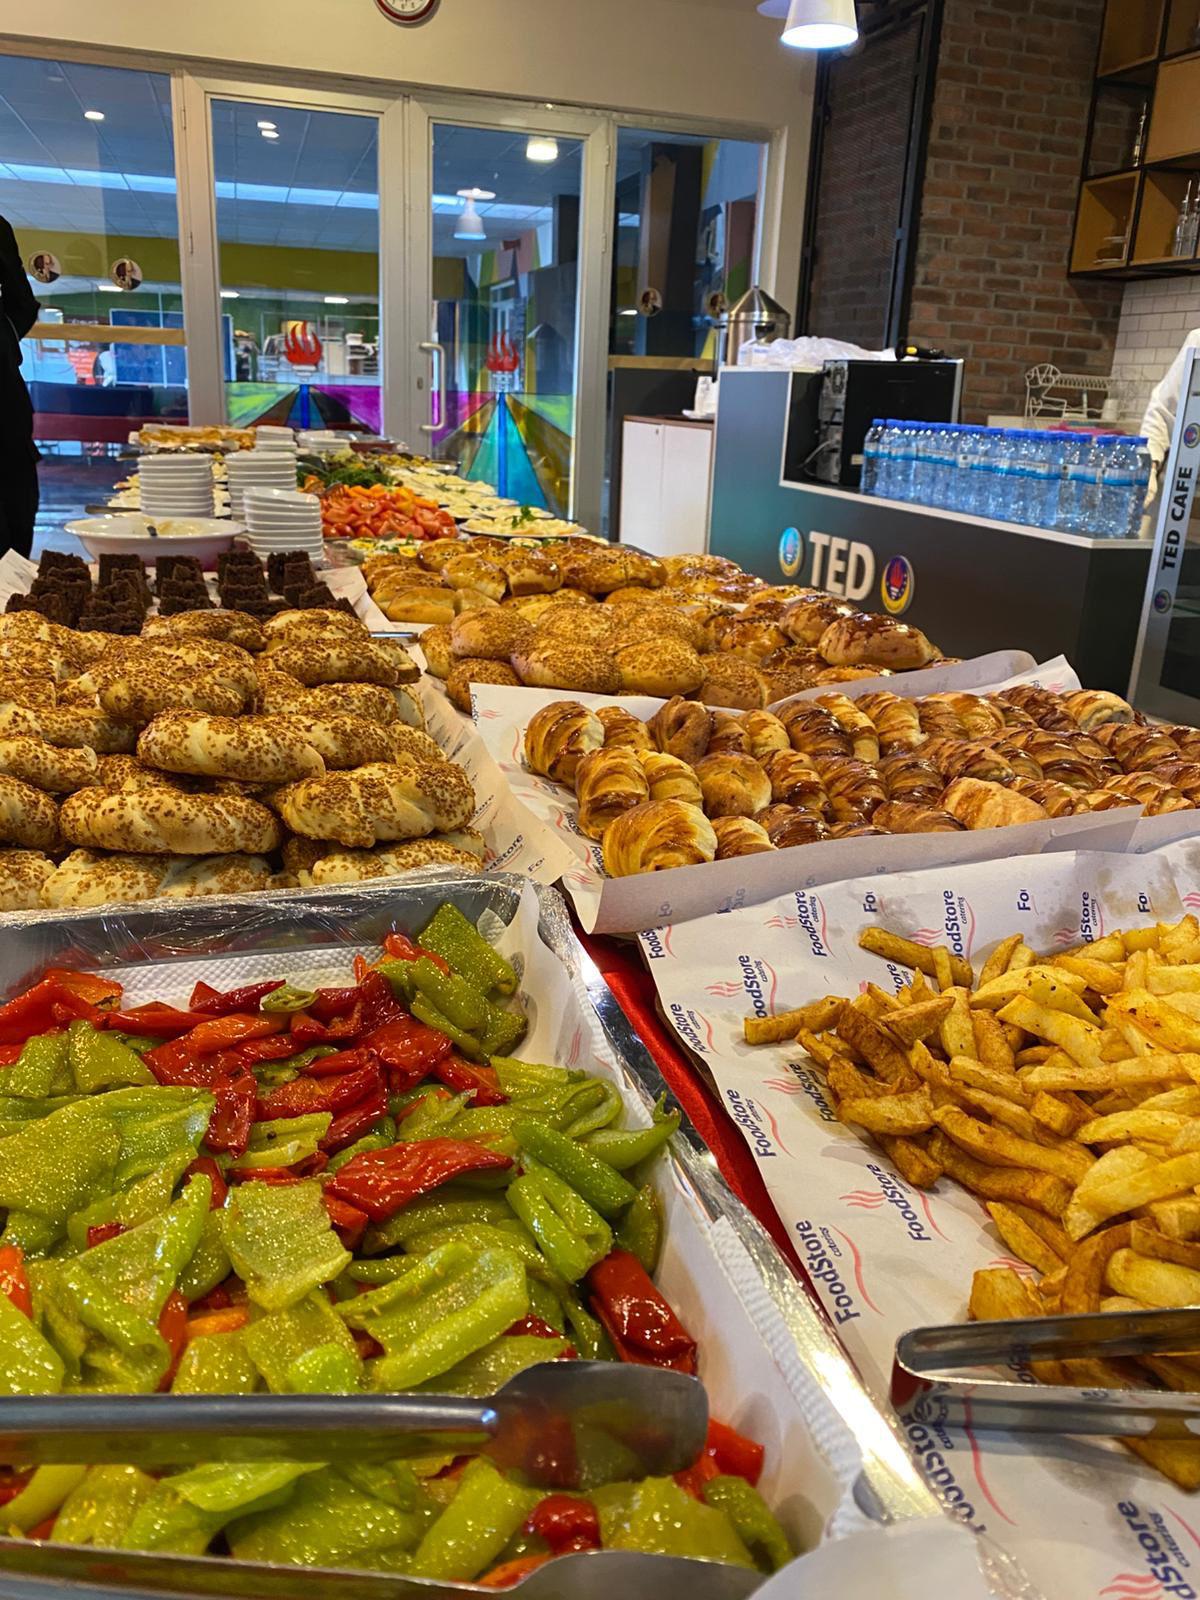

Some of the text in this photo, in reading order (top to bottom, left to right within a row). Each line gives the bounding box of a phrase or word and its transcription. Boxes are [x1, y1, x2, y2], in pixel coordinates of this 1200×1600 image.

[1161, 466, 1193, 571] TED CAFE
[808, 531, 876, 601] TED
[795, 891, 828, 957] FoodStore
[809, 896, 820, 923] catering
[957, 896, 967, 924] catering
[1090, 896, 1098, 926] catering
[726, 1088, 777, 1158] FoodStore
[866, 1163, 933, 1242] FoodStore
[795, 1220, 861, 1324] FoodStore
[819, 1226, 842, 1258] catering
[1148, 1511, 1191, 1568] catering
